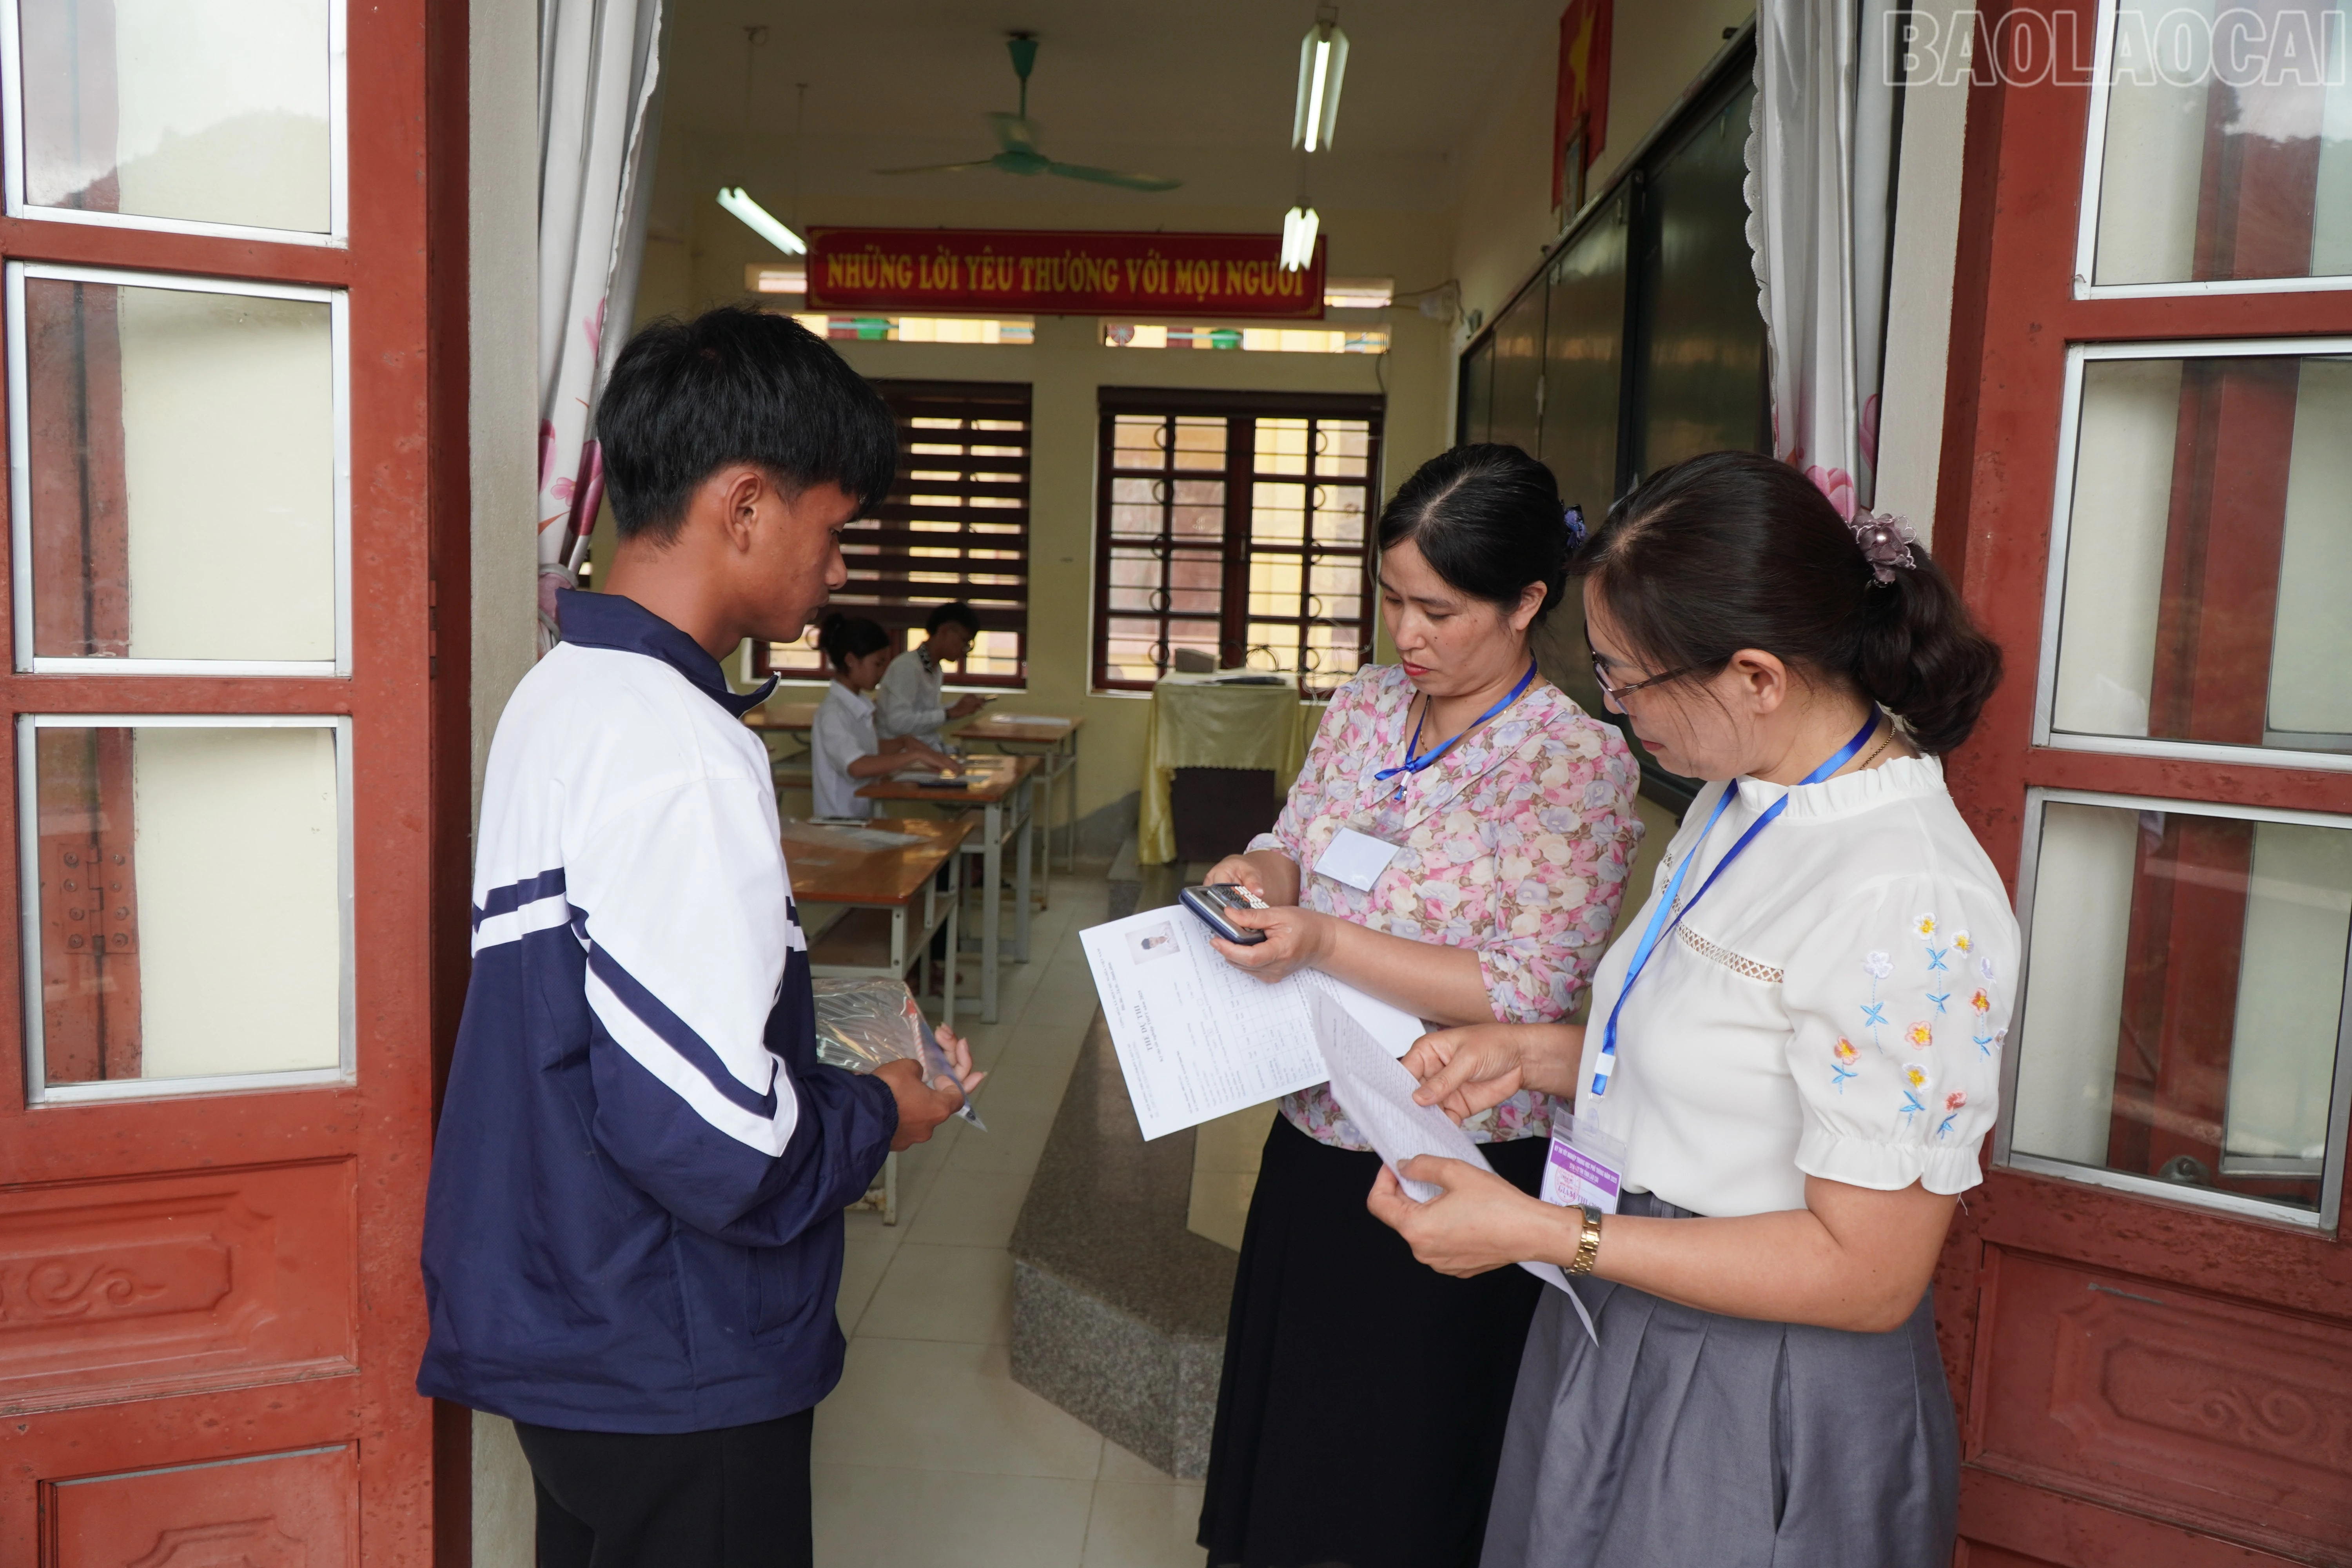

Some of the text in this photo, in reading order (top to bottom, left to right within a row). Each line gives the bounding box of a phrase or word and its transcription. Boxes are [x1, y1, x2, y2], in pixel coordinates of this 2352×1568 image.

[827, 244, 913, 289] NHỮNG
[918, 244, 958, 290] LỜI
[964, 245, 1014, 291] YÊU
[1020, 249, 1120, 294] THƯƠNG
[1125, 247, 1170, 294] VỚI
[1174, 258, 1220, 303] MỌI
[1133, 1004, 1143, 1020] THI
